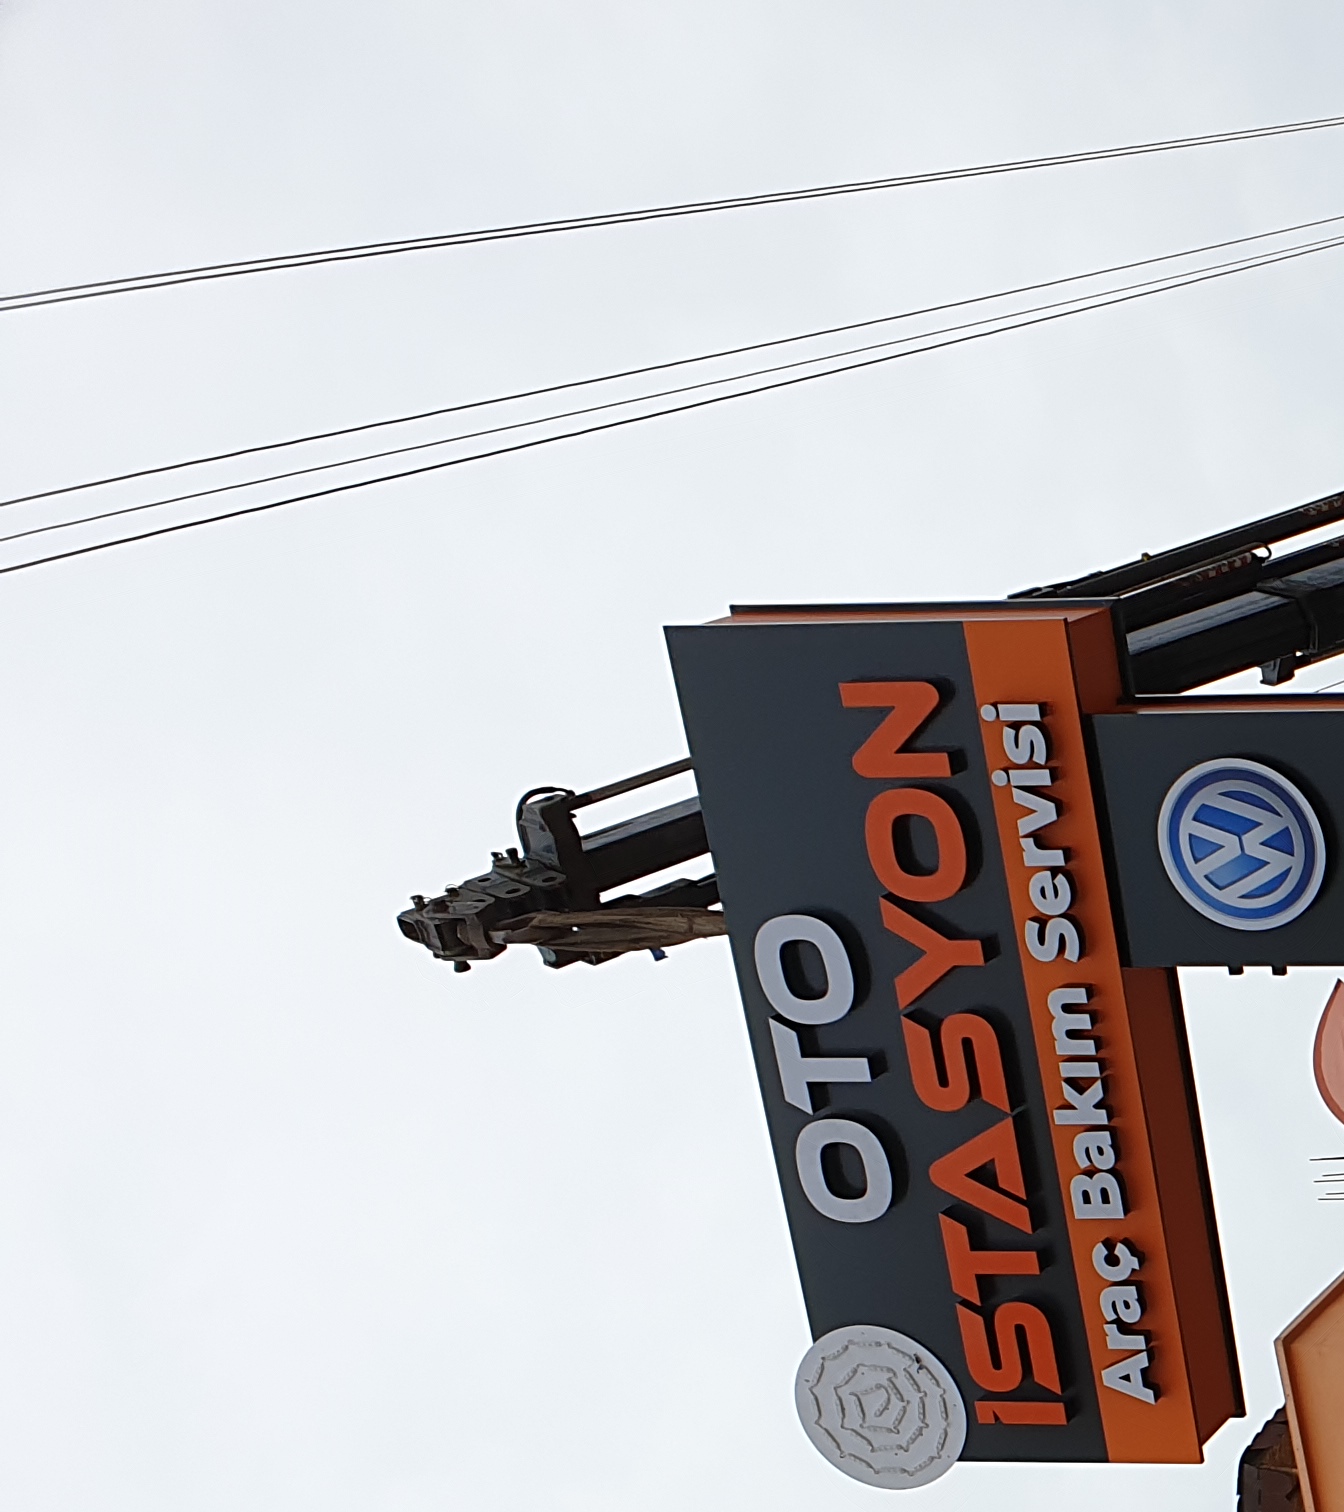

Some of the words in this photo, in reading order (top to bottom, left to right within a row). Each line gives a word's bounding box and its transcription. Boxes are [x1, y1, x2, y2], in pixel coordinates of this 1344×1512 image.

[980, 700, 1083, 963] Servisi
[752, 914, 894, 1223] OTO
[1044, 986, 1130, 1221] Bakım
[1092, 1242, 1159, 1404] Araç
